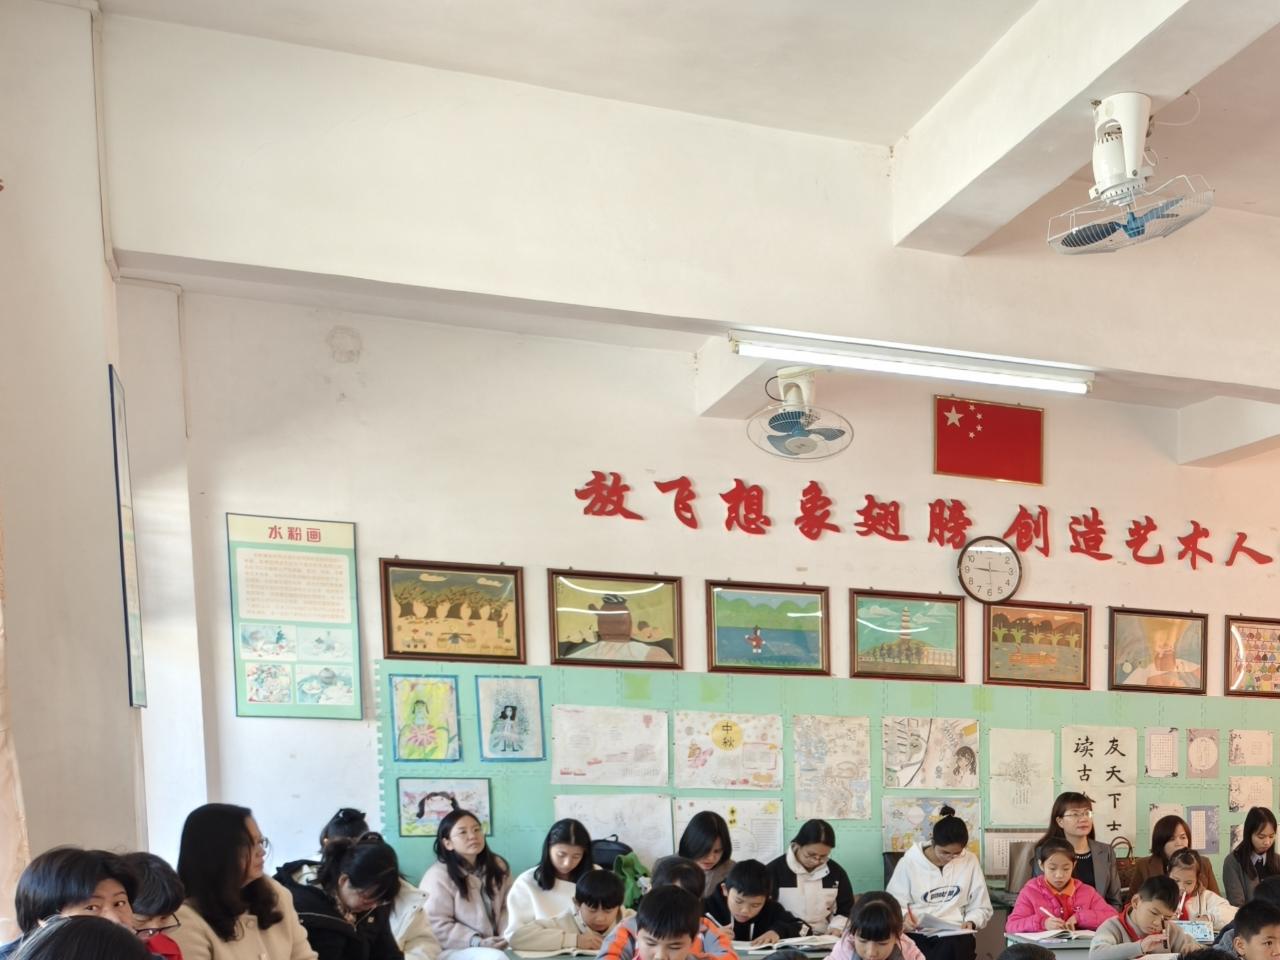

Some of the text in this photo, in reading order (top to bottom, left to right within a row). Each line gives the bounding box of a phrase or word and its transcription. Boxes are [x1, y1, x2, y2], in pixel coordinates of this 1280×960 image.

[267, 524, 322, 543] 水粉画
[574, 470, 973, 550] 放飞想象翅膀
[721, 721, 735, 748] 中秋
[1104, 736, 1126, 832] 友天下士
